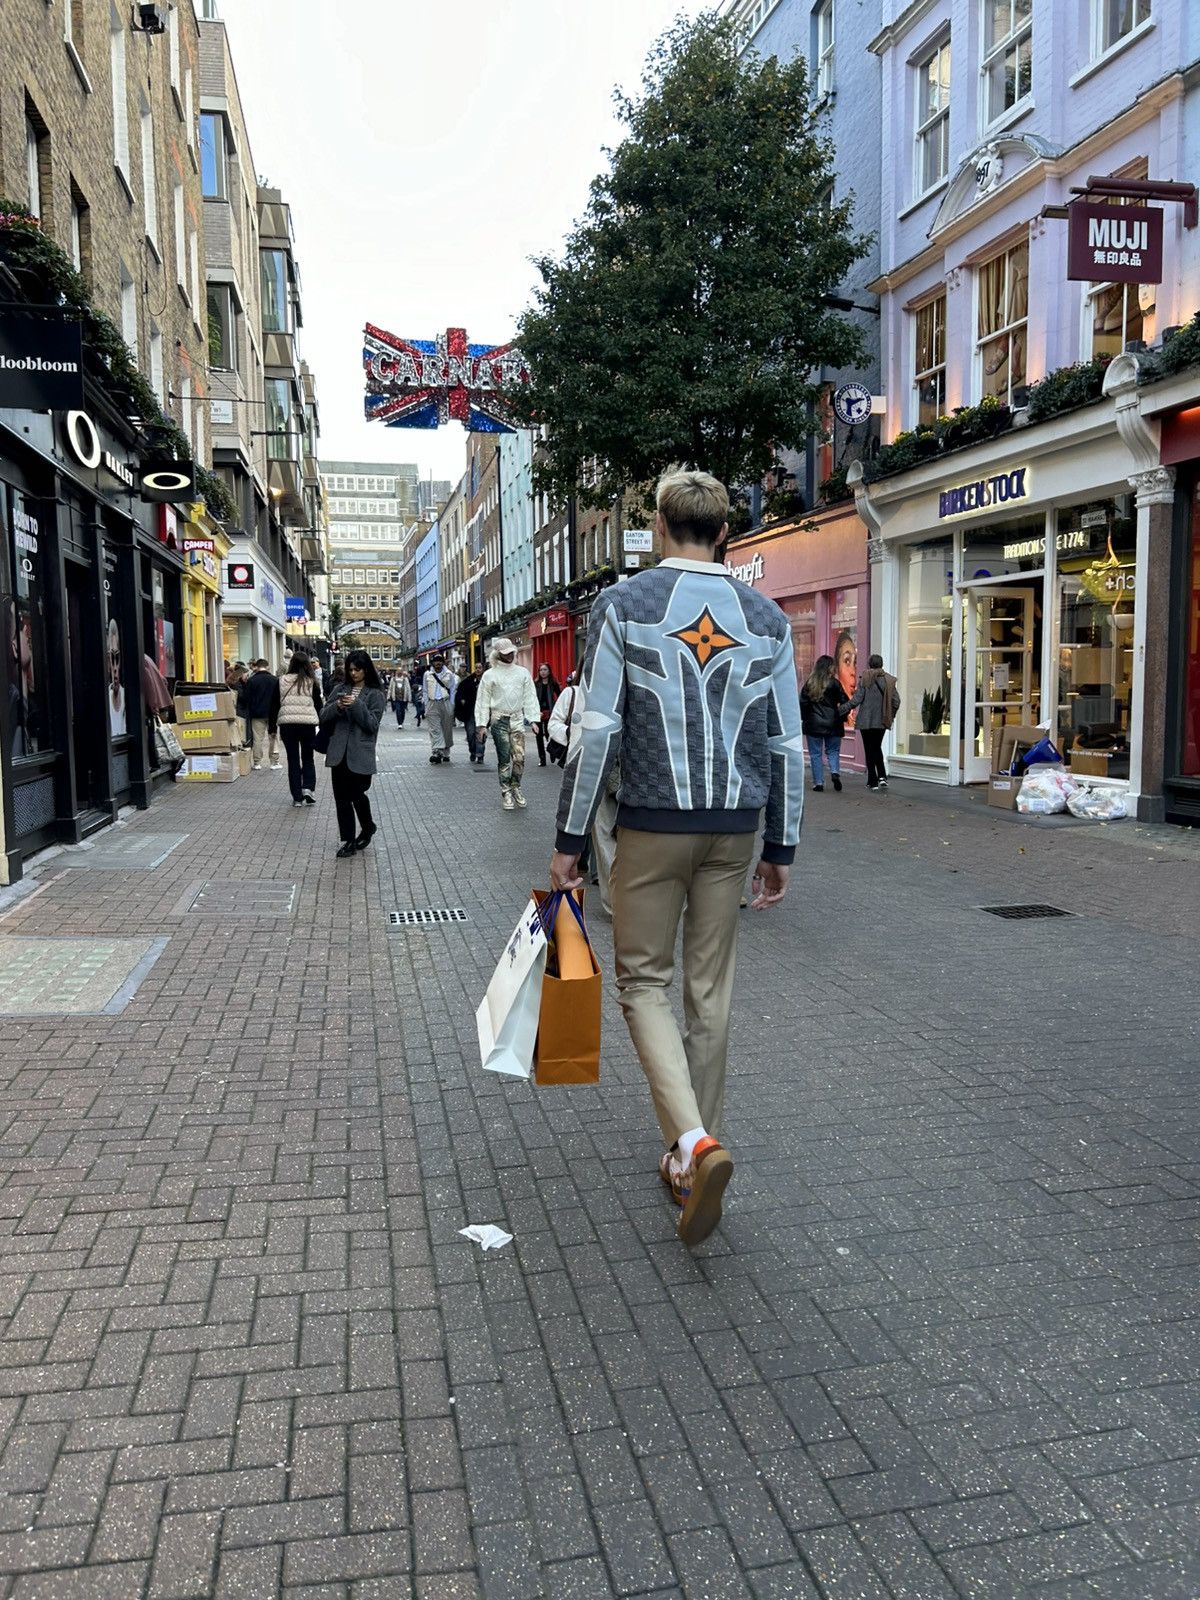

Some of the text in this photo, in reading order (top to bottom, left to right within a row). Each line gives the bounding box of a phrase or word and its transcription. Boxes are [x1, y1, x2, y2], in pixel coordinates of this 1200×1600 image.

[1088, 218, 1148, 250] MUJI
[1093, 250, 1142, 267] 無印良品
[370, 351, 526, 391] CARNAB
[105, 451, 134, 487] OAKLEY
[939, 468, 1026, 518] BIRKENSTOCK
[30, 516, 38, 536] TO
[184, 540, 213, 551] CAMPER
[1003, 539, 1039, 559] TRADITION
[1064, 531, 1085, 549] 1774
[727, 552, 764, 587] benefit
